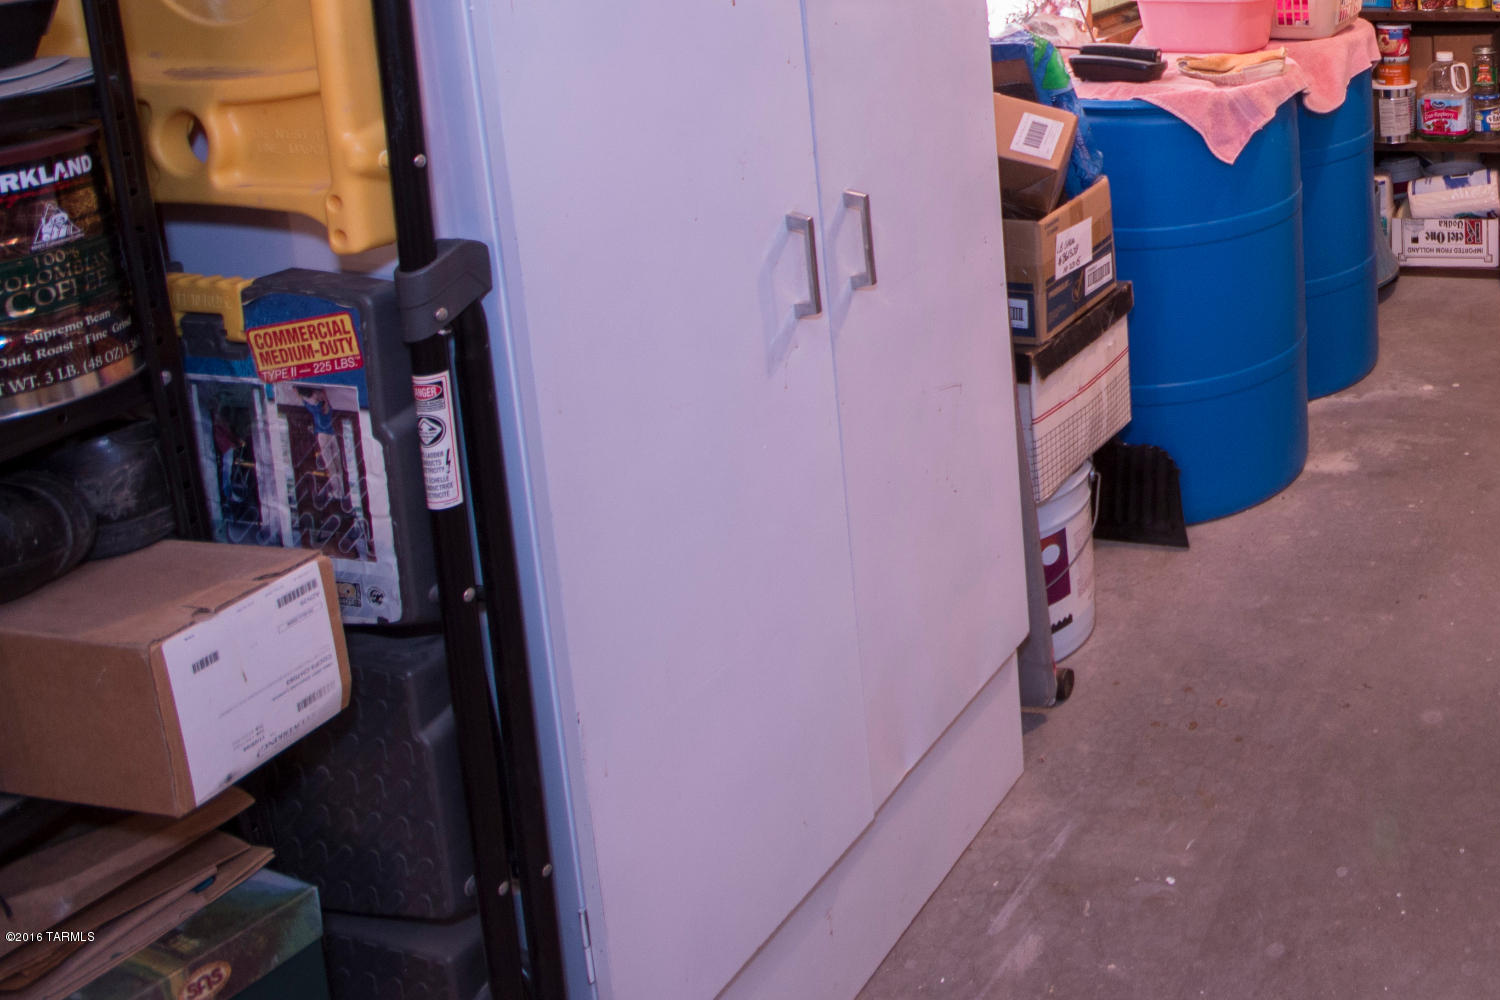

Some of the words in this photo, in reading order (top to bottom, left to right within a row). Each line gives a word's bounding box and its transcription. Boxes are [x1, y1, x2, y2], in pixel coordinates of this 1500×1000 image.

[1425, 231, 1445, 243] One
[24, 320, 84, 344] Supremo
[85, 310, 111, 326] Bean
[253, 318, 351, 350] COMMERCIAL
[36, 341, 74, 360] Roast
[85, 329, 108, 345] Fine
[259, 336, 354, 368] MEDIUM-DUTY
[9, 375, 41, 394] WT.
[45, 371, 54, 384] 3
[58, 364, 80, 381] LB.
[83, 355, 103, 374] (48
[261, 368, 288, 381] TYPE
[313, 361, 332, 375] 225
[334, 358, 359, 370] LBS.
